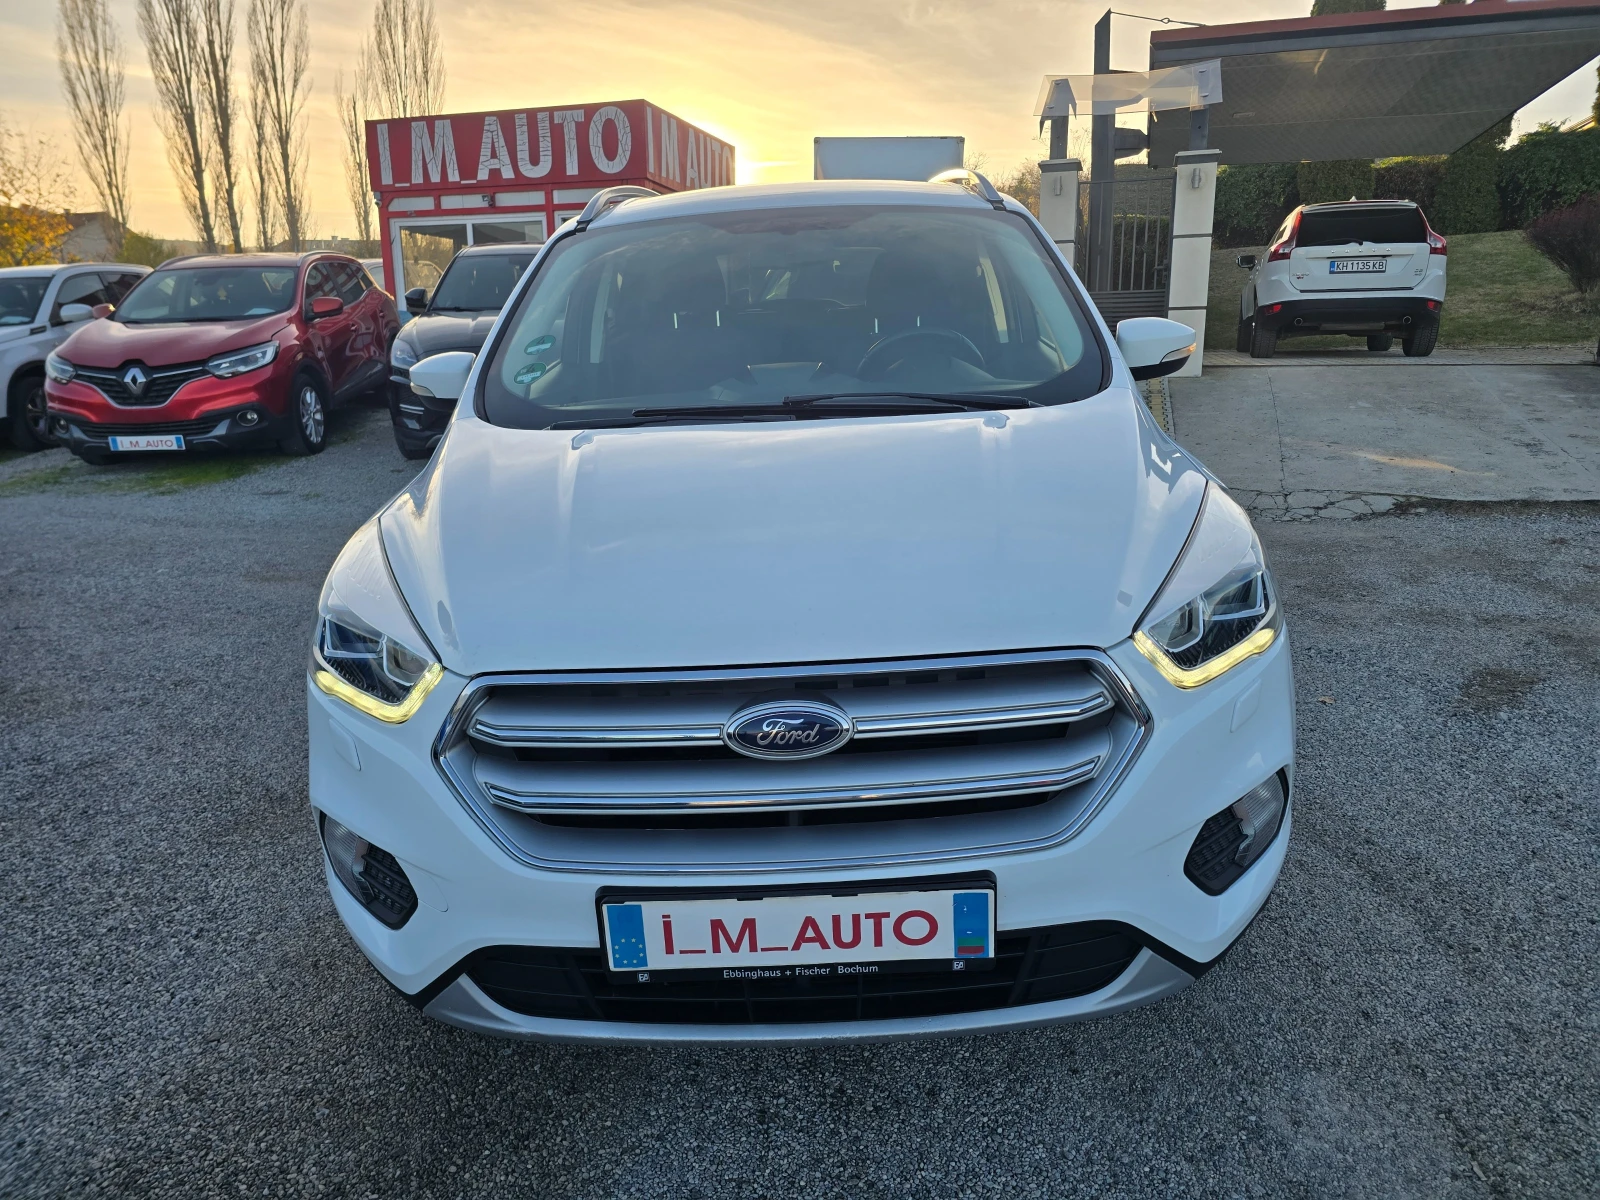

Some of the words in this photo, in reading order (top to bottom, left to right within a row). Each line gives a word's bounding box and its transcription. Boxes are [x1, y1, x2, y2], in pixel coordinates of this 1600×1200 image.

[376, 105, 632, 187] I_M_AUTO
[686, 127, 732, 189] AUTO
[1336, 262, 1348, 271] KH
[1351, 262, 1370, 271] 1135
[1372, 261, 1384, 270] KB
[756, 718, 821, 746] Ford
[723, 968, 781, 979] Ebbinghaus
[784, 969, 792, 977] +
[795, 966, 831, 976] Fischer
[838, 964, 879, 974] Bochum
